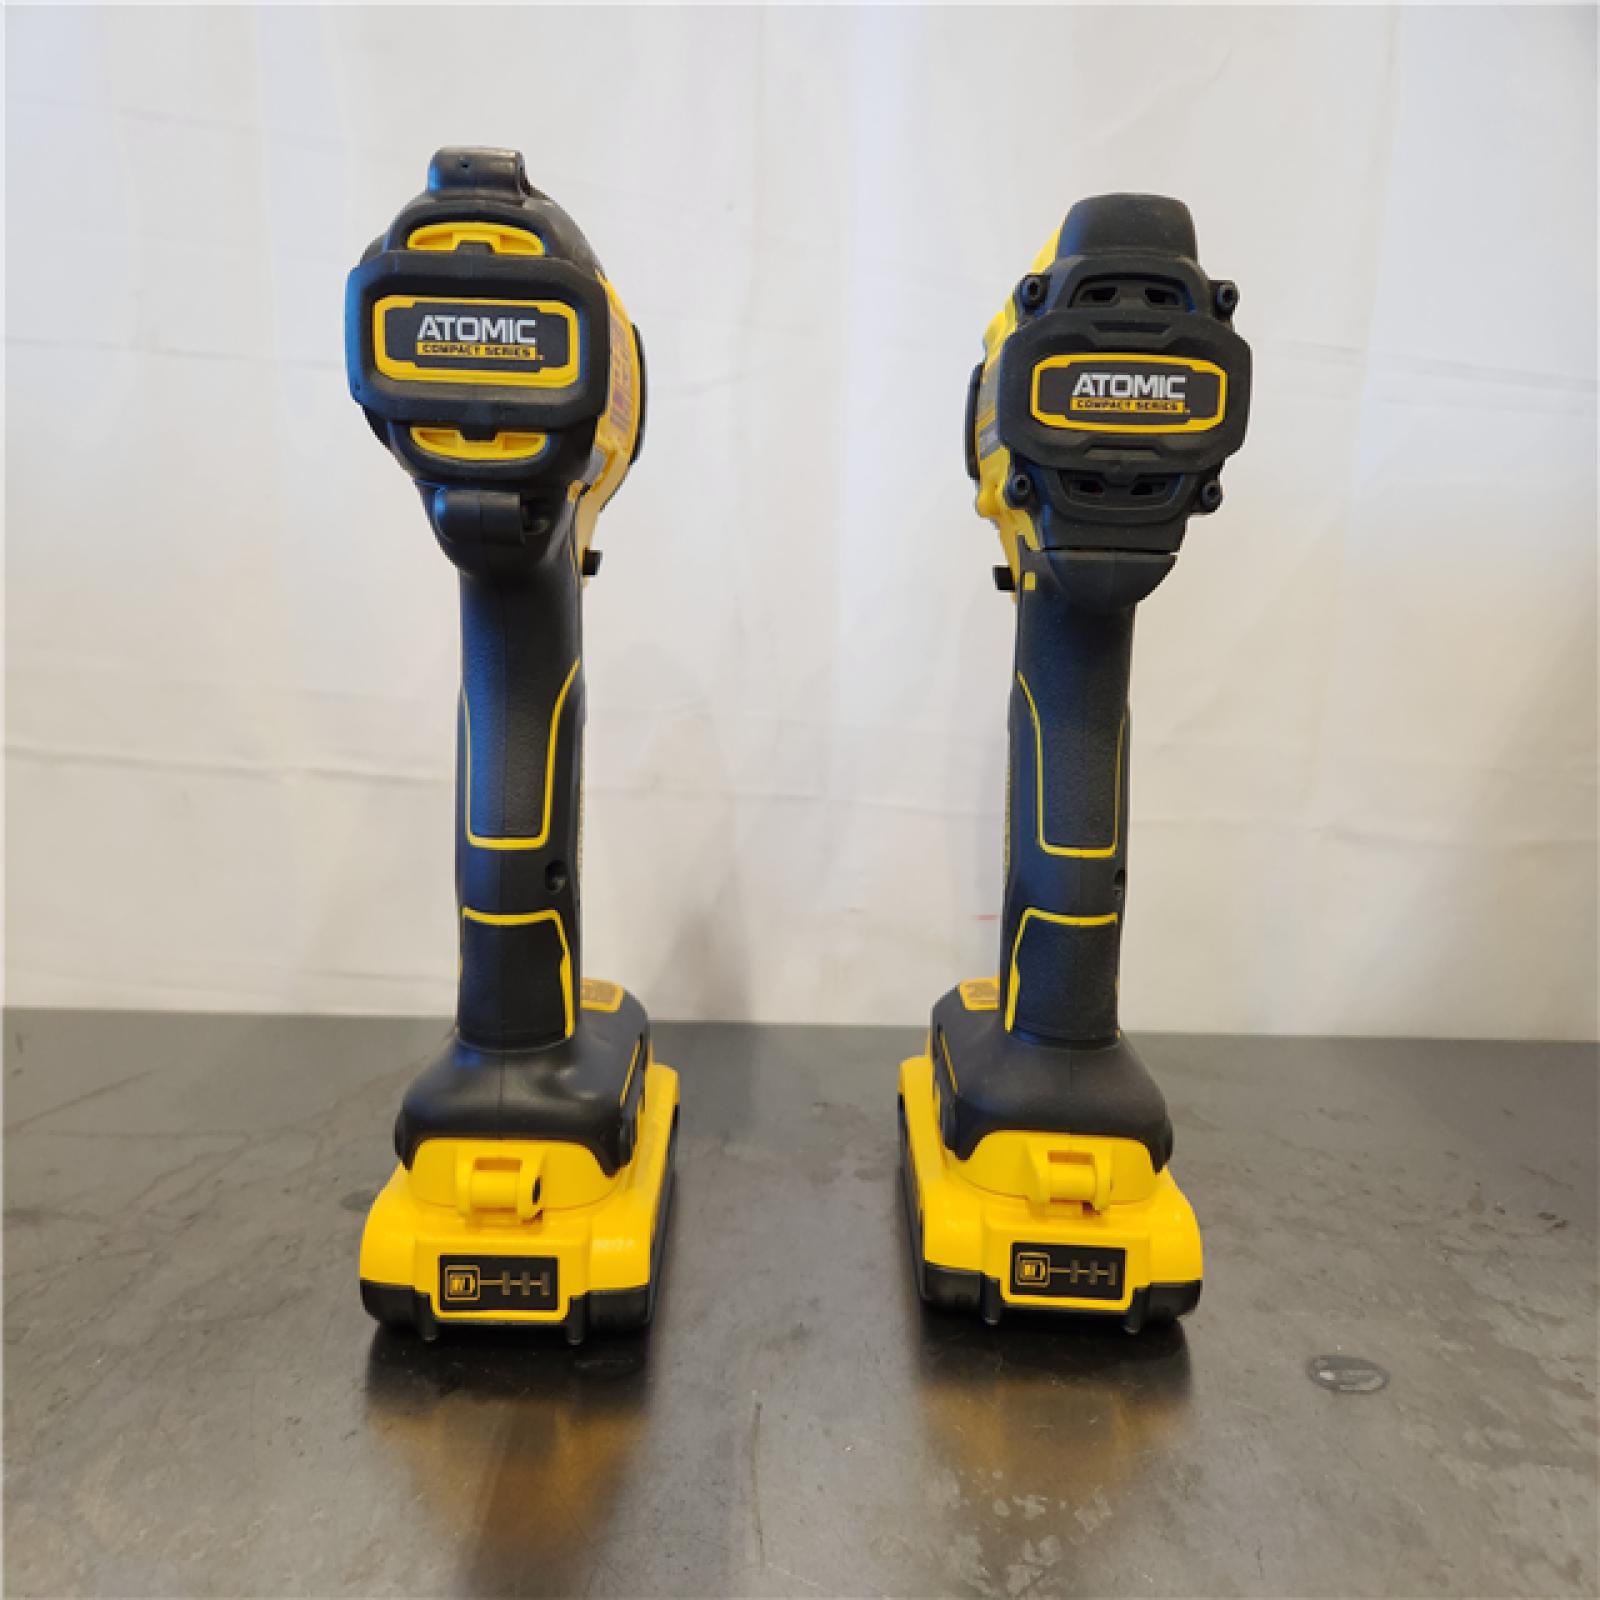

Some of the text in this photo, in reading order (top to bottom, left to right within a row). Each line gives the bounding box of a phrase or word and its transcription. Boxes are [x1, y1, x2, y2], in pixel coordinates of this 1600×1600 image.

[417, 314, 536, 344] ATOMIC
[422, 343, 530, 358] COMPACT SERIES
[1072, 373, 1186, 399] ATOMIC
[1077, 400, 1178, 412] COMPACT SERIES
